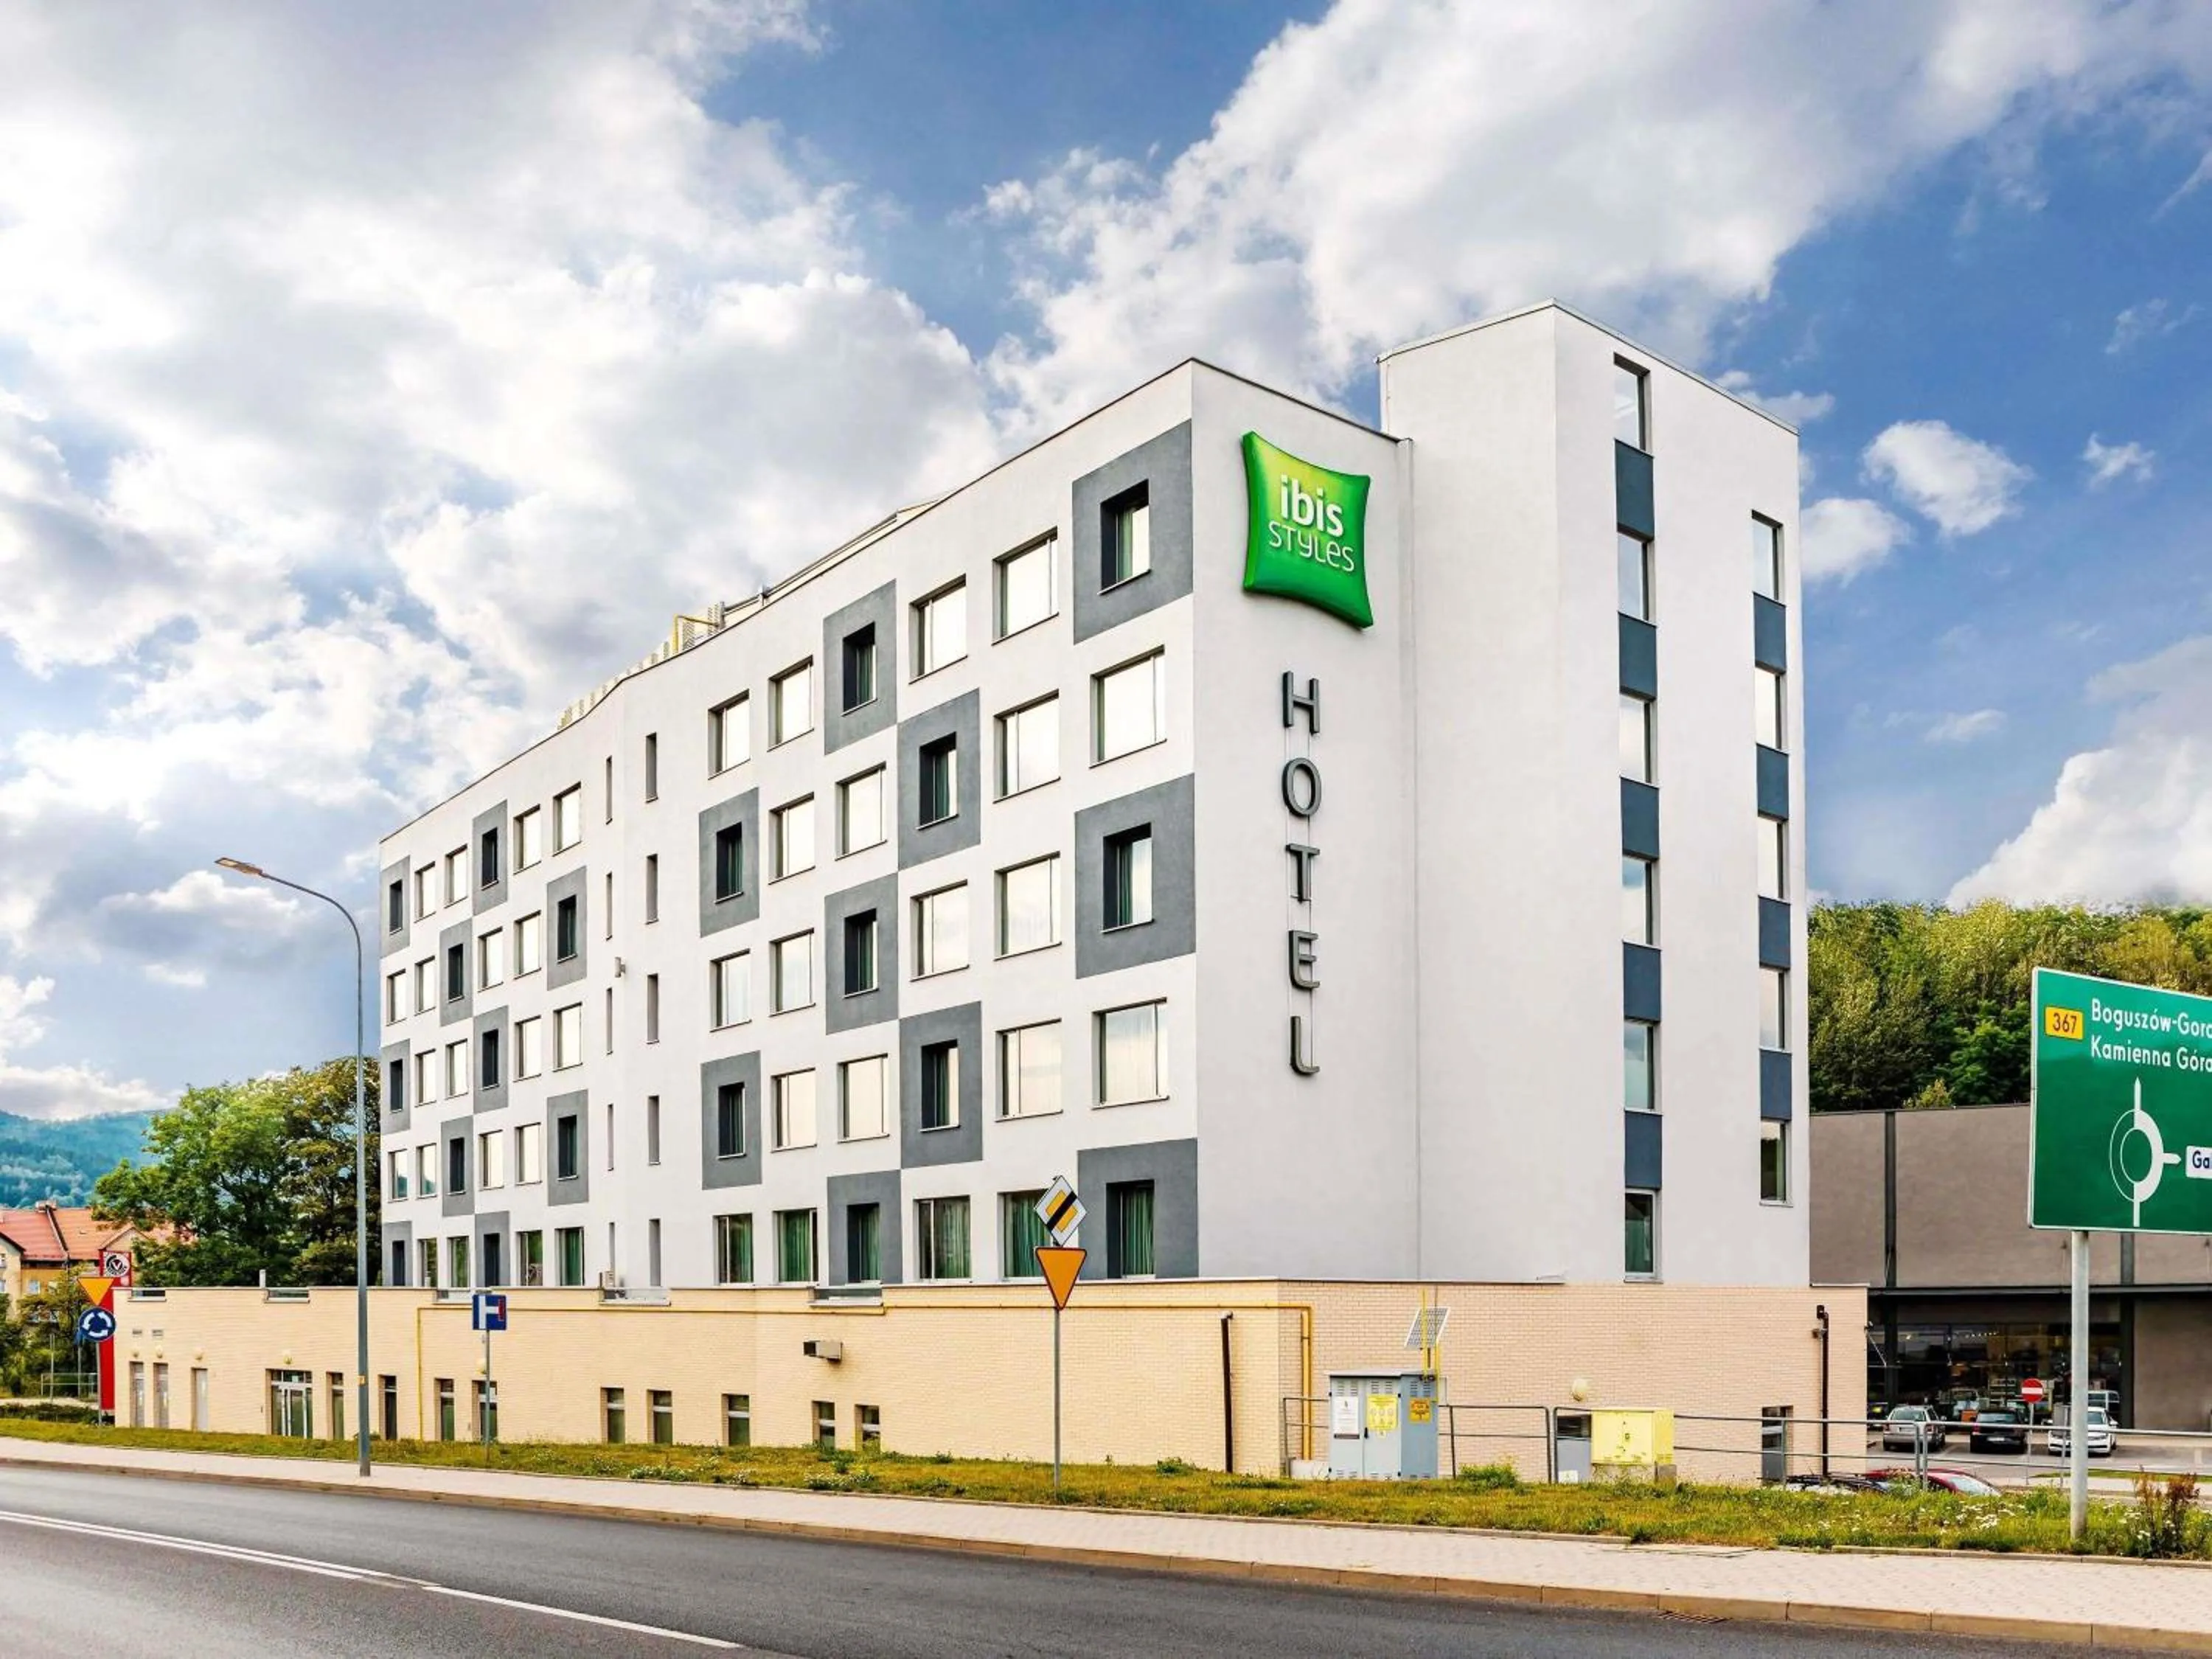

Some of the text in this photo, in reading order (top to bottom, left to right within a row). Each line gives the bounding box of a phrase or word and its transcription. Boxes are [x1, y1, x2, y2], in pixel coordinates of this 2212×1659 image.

[1281, 474, 1343, 537] ibis
[1282, 670, 1321, 1075] HOTEL
[2053, 1012, 2077, 1034] 367
[2091, 1034, 2171, 1067] Kamienna
[2192, 1150, 2212, 1169] Ga
